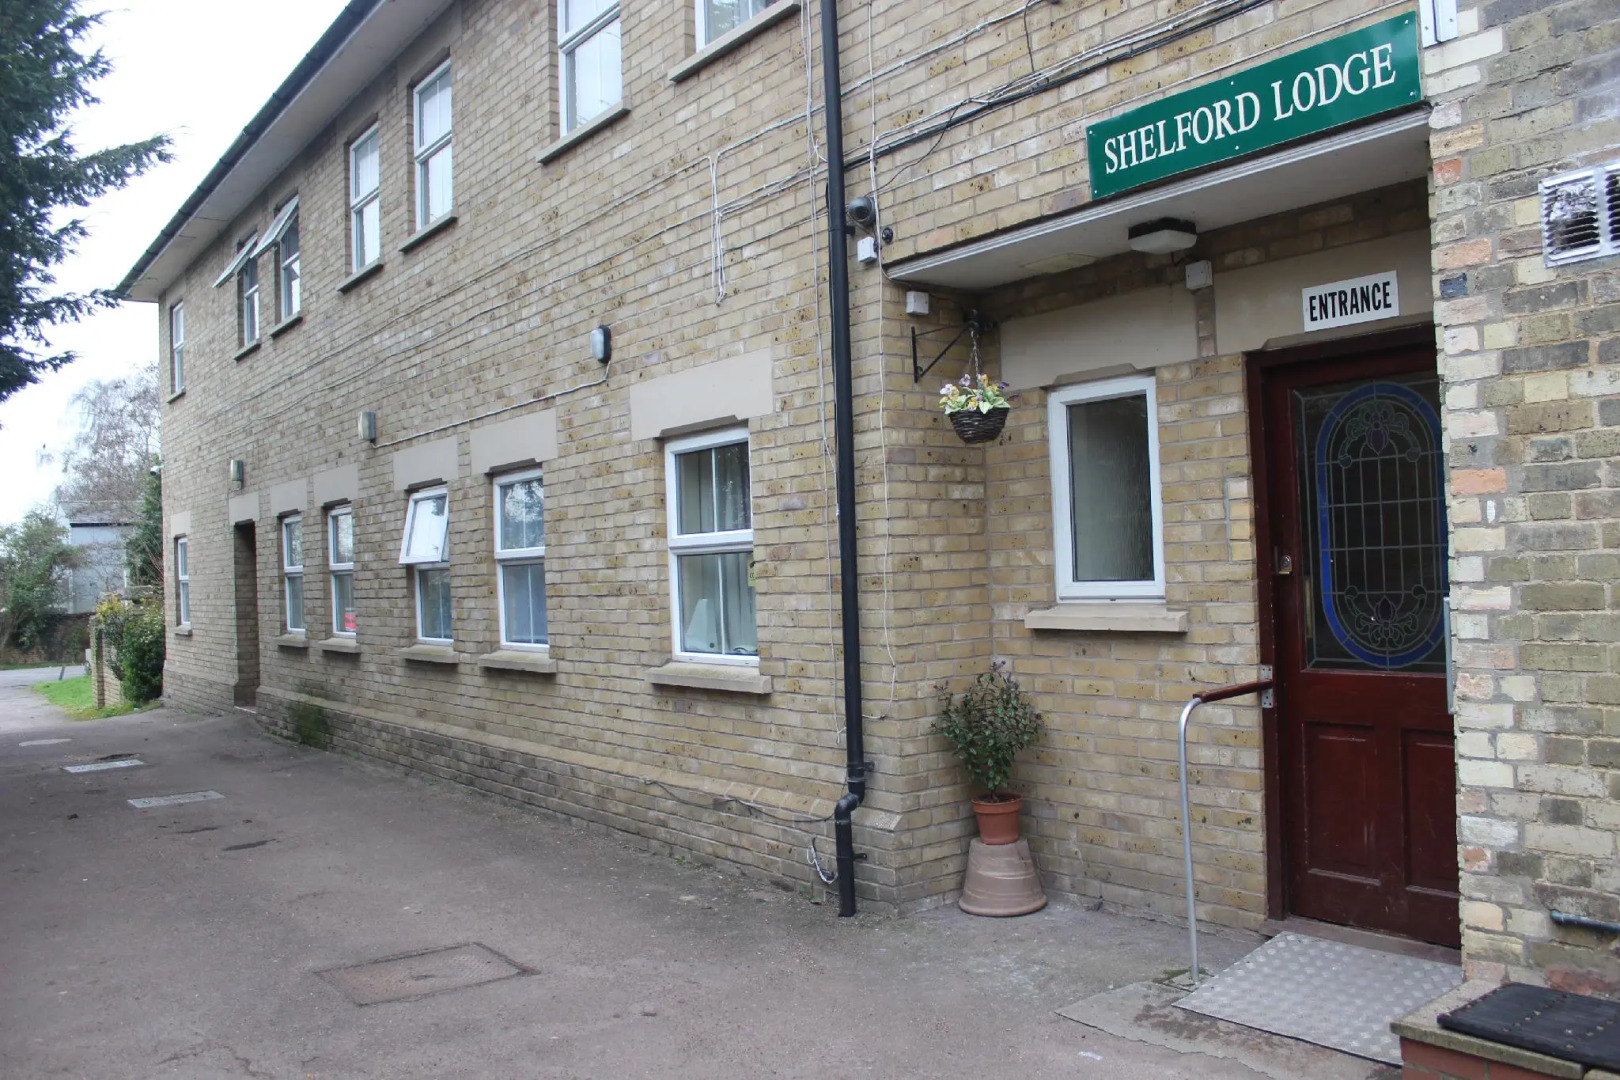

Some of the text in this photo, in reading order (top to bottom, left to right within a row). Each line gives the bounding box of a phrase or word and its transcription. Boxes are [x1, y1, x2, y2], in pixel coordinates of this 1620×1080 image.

[1104, 43, 1396, 175] SHELFORD LODGE
[1309, 281, 1392, 322] ENTRANCE
